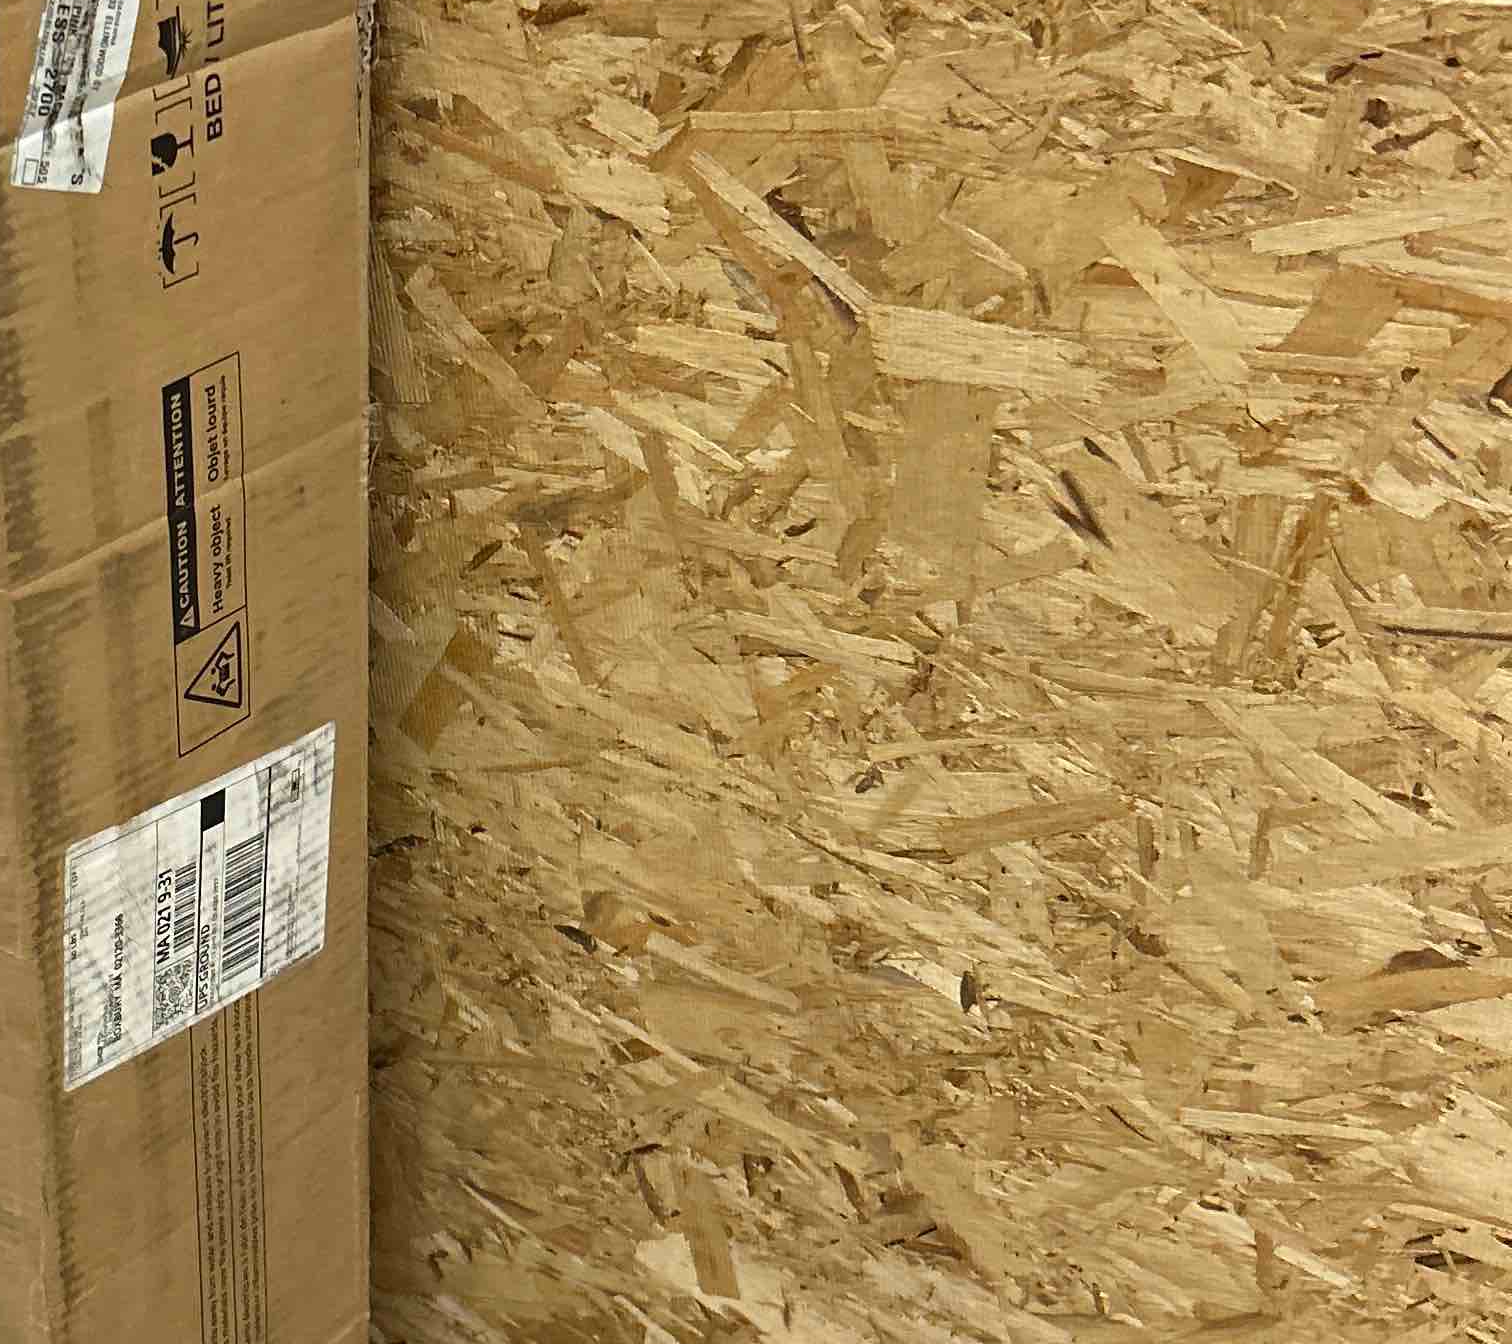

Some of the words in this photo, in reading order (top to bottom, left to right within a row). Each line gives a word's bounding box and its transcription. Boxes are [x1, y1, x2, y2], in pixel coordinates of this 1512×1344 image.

[205, 0, 225, 47] LIT
[38, 67, 58, 117] 2700
[205, 72, 223, 143] BED
[206, 385, 218, 433] lourd
[170, 392, 187, 509] ATTENTION
[207, 436, 221, 483] Objet
[211, 503, 224, 557] object
[178, 520, 189, 610] CAUTION
[211, 562, 228, 615] Heavy
[157, 866, 172, 904] 9-31
[156, 903, 171, 937] 021
[156, 934, 170, 965] MA
[198, 921, 210, 983] GROUND
[198, 980, 208, 1011] UPS
